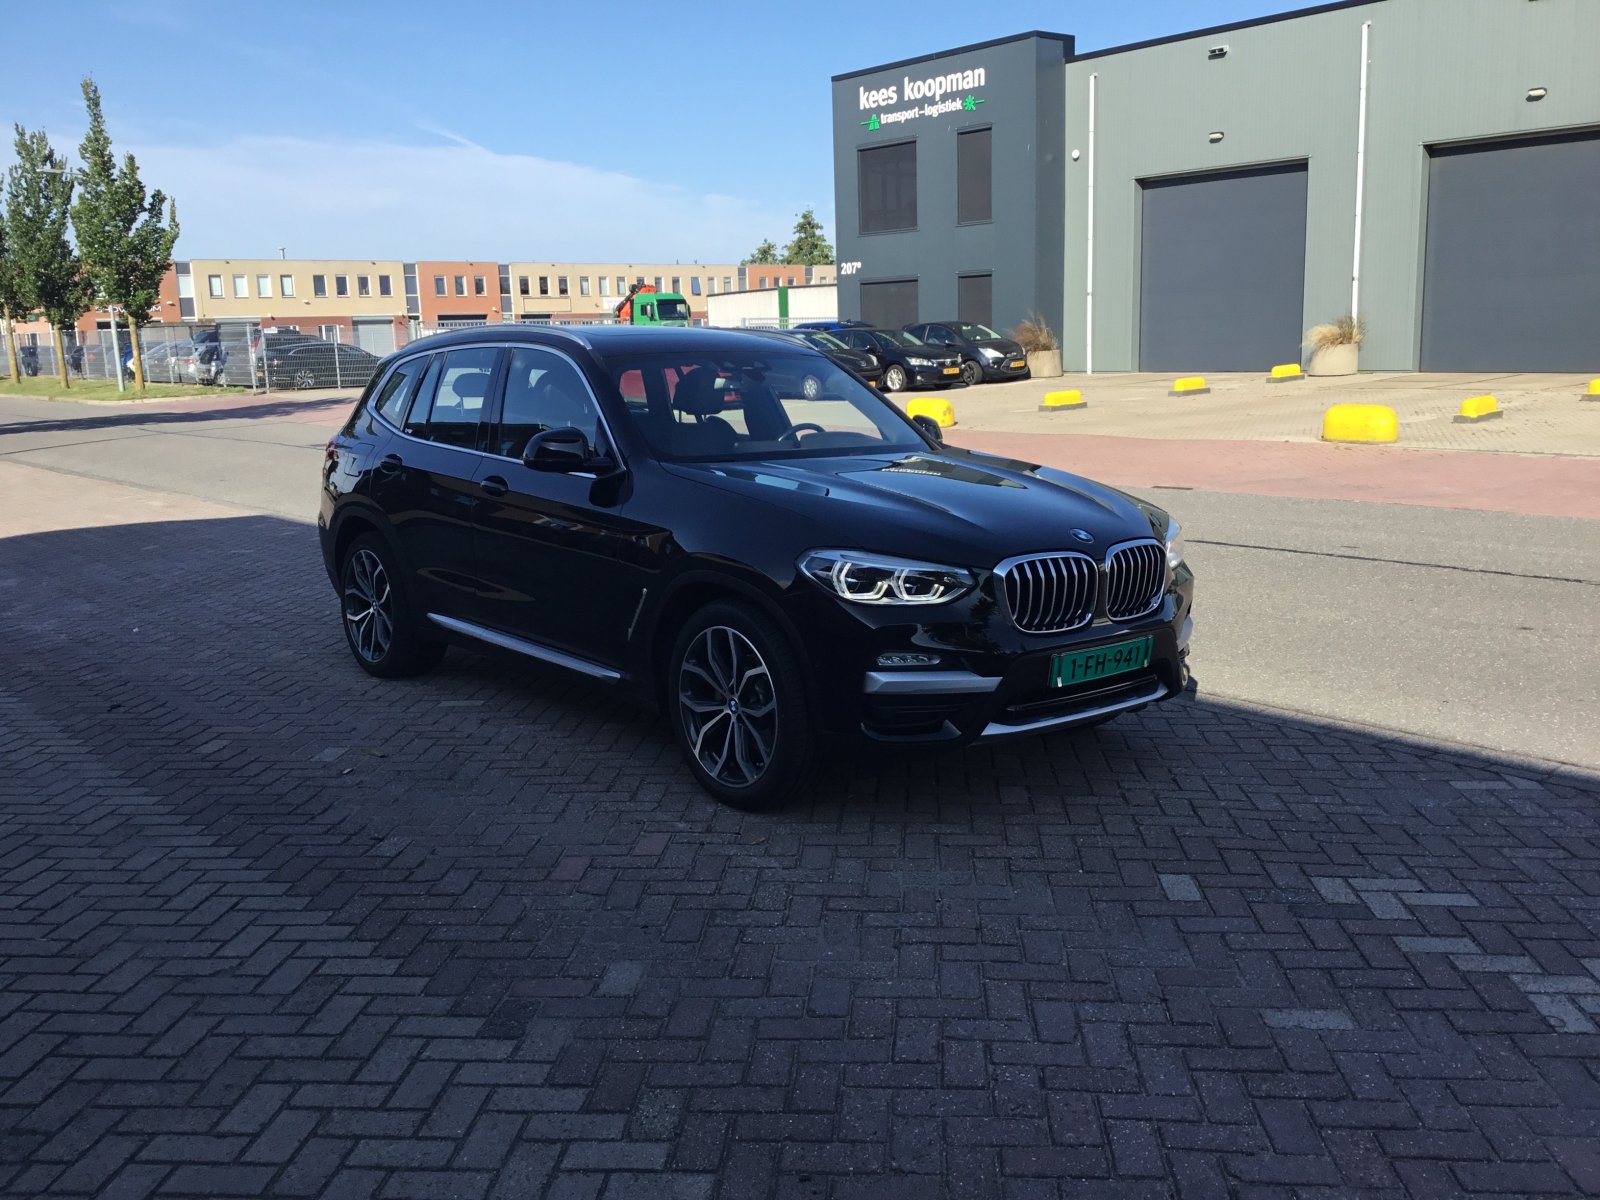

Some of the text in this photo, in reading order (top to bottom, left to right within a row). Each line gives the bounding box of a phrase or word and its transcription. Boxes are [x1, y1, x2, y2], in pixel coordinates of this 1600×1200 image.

[859, 67, 986, 110] kees koopman
[1071, 645, 1141, 680] 1-FH-941
